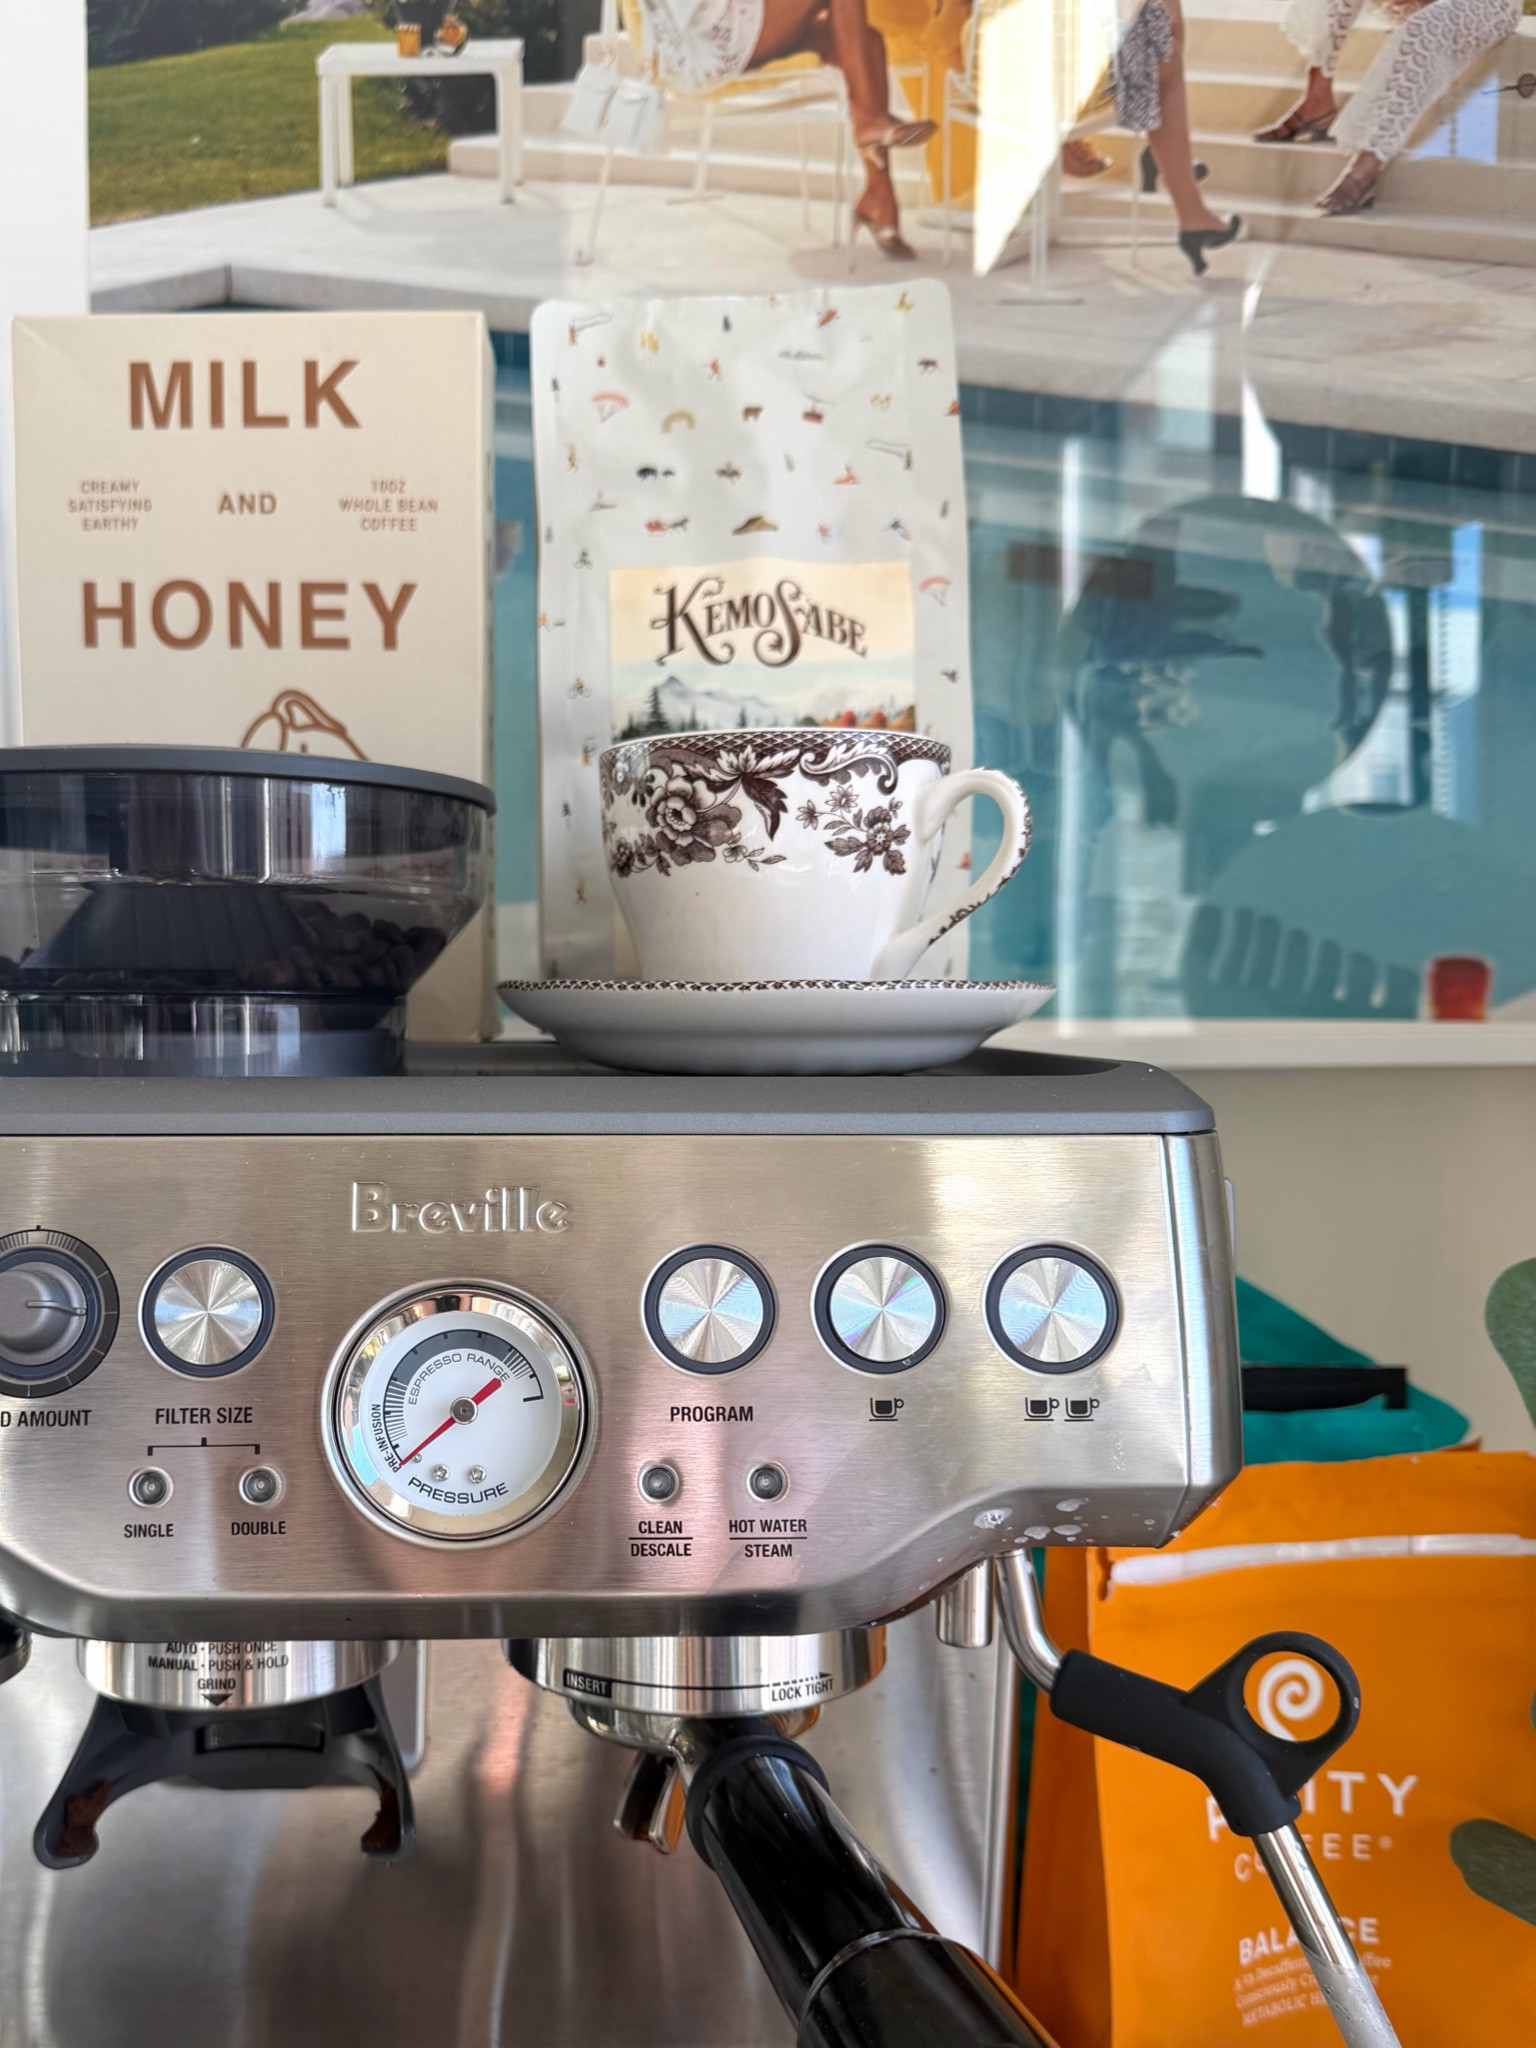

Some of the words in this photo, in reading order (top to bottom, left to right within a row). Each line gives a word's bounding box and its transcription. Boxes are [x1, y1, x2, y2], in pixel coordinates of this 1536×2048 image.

[128, 358, 362, 430] MILK
[80, 479, 141, 495] CREAMY
[67, 499, 153, 514] SATISFYING
[217, 493, 278, 516] AND
[338, 499, 393, 513] WHOLE
[396, 499, 439, 513] BEAN
[82, 517, 140, 532] EARTHY
[359, 517, 418, 532] COFFEE
[81, 578, 418, 652] HONEY
[351, 1181, 572, 1235] Breville
[408, 1352, 463, 1406] ESPRESSO
[466, 1352, 511, 1384] RANGE
[17, 1409, 92, 1428] AMOUNT
[155, 1407, 211, 1425] FILTER
[216, 1406, 254, 1424] SIZE
[670, 1405, 754, 1422] PROGRAM
[370, 1403, 403, 1474] PRE-INFUSION
[407, 1476, 510, 1505] PRESSURE
[123, 1523, 174, 1538] SINGLE
[231, 1521, 287, 1536] DOUBLE
[638, 1520, 683, 1534] CLEAN
[728, 1519, 756, 1533] HOT
[759, 1518, 808, 1532] WATER
[630, 1543, 692, 1557] DESCALE
[744, 1543, 793, 1558] STEAM
[166, 1642, 197, 1655] AUTO
[208, 1642, 240, 1655] PUSH
[244, 1641, 277, 1653] ONCE
[148, 1655, 198, 1671] MANUAL
[208, 1659, 241, 1671] PUSH
[244, 1658, 254, 1670] &
[257, 1655, 289, 1670] HOLD
[197, 1678, 236, 1690] GRIND
[566, 1671, 608, 1695] INSERT
[771, 1687, 802, 1702] LOCK
[804, 1678, 834, 1697] TIGHT
